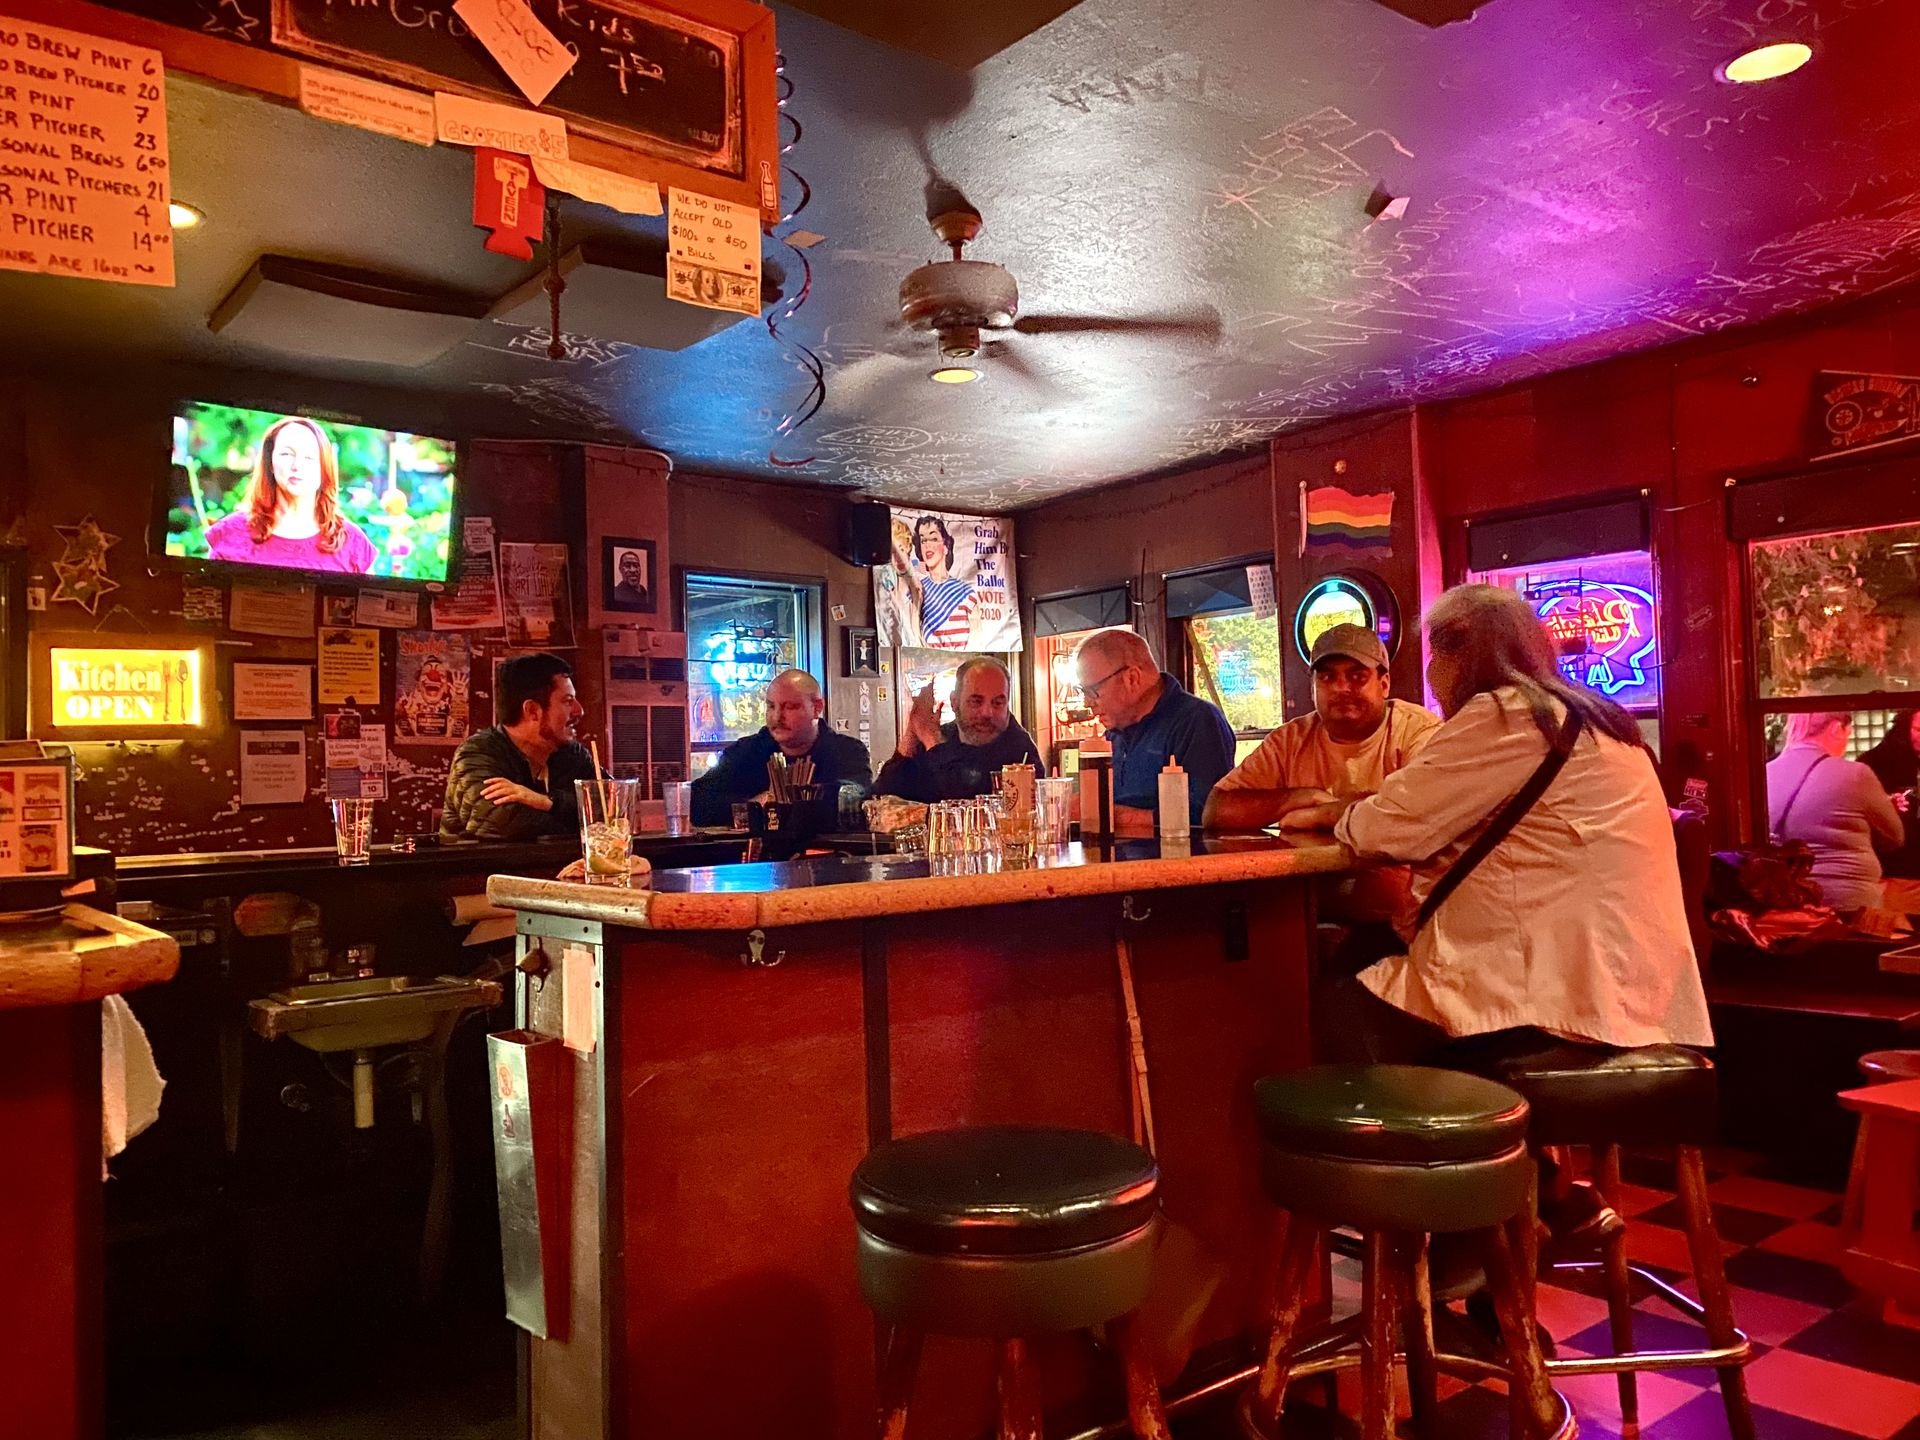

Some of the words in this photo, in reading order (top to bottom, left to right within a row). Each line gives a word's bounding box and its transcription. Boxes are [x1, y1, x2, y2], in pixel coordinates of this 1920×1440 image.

[27, 33, 80, 60] BREW
[92, 50, 132, 70] PINT
[142, 59, 156, 76] 6
[15, 61, 58, 80] BREW
[63, 68, 127, 95] PITCHER
[138, 83, 160, 101] 20
[29, 90, 76, 111] PINT
[134, 105, 150, 123] 7
[30, 113, 105, 142] PITCHER
[134, 132, 157, 151] 23
[71, 144, 125, 169] BREWS
[65, 168, 141, 197] PITCHERS
[147, 181, 164, 202] 21
[26, 188, 77, 213] PINT
[678, 193, 691, 205] WE
[695, 197, 708, 209] DO
[714, 203, 732, 213] NOT
[134, 204, 151, 226] 4
[673, 208, 704, 223] ACCEPT
[712, 217, 732, 229] OLD
[11, 213, 94, 242] PITCHER
[725, 234, 747, 250] $50
[48, 253, 82, 272] ARE
[974, 525, 999, 539] Grab
[974, 541, 998, 555] Him
[973, 558, 996, 571] The
[976, 574, 1005, 588] Ballot
[977, 591, 1005, 605] VOTE
[980, 608, 1002, 621] 2020
[58, 659, 162, 692] Kitchen
[65, 694, 154, 719] OPEN
[367, 785, 377, 793] 10
